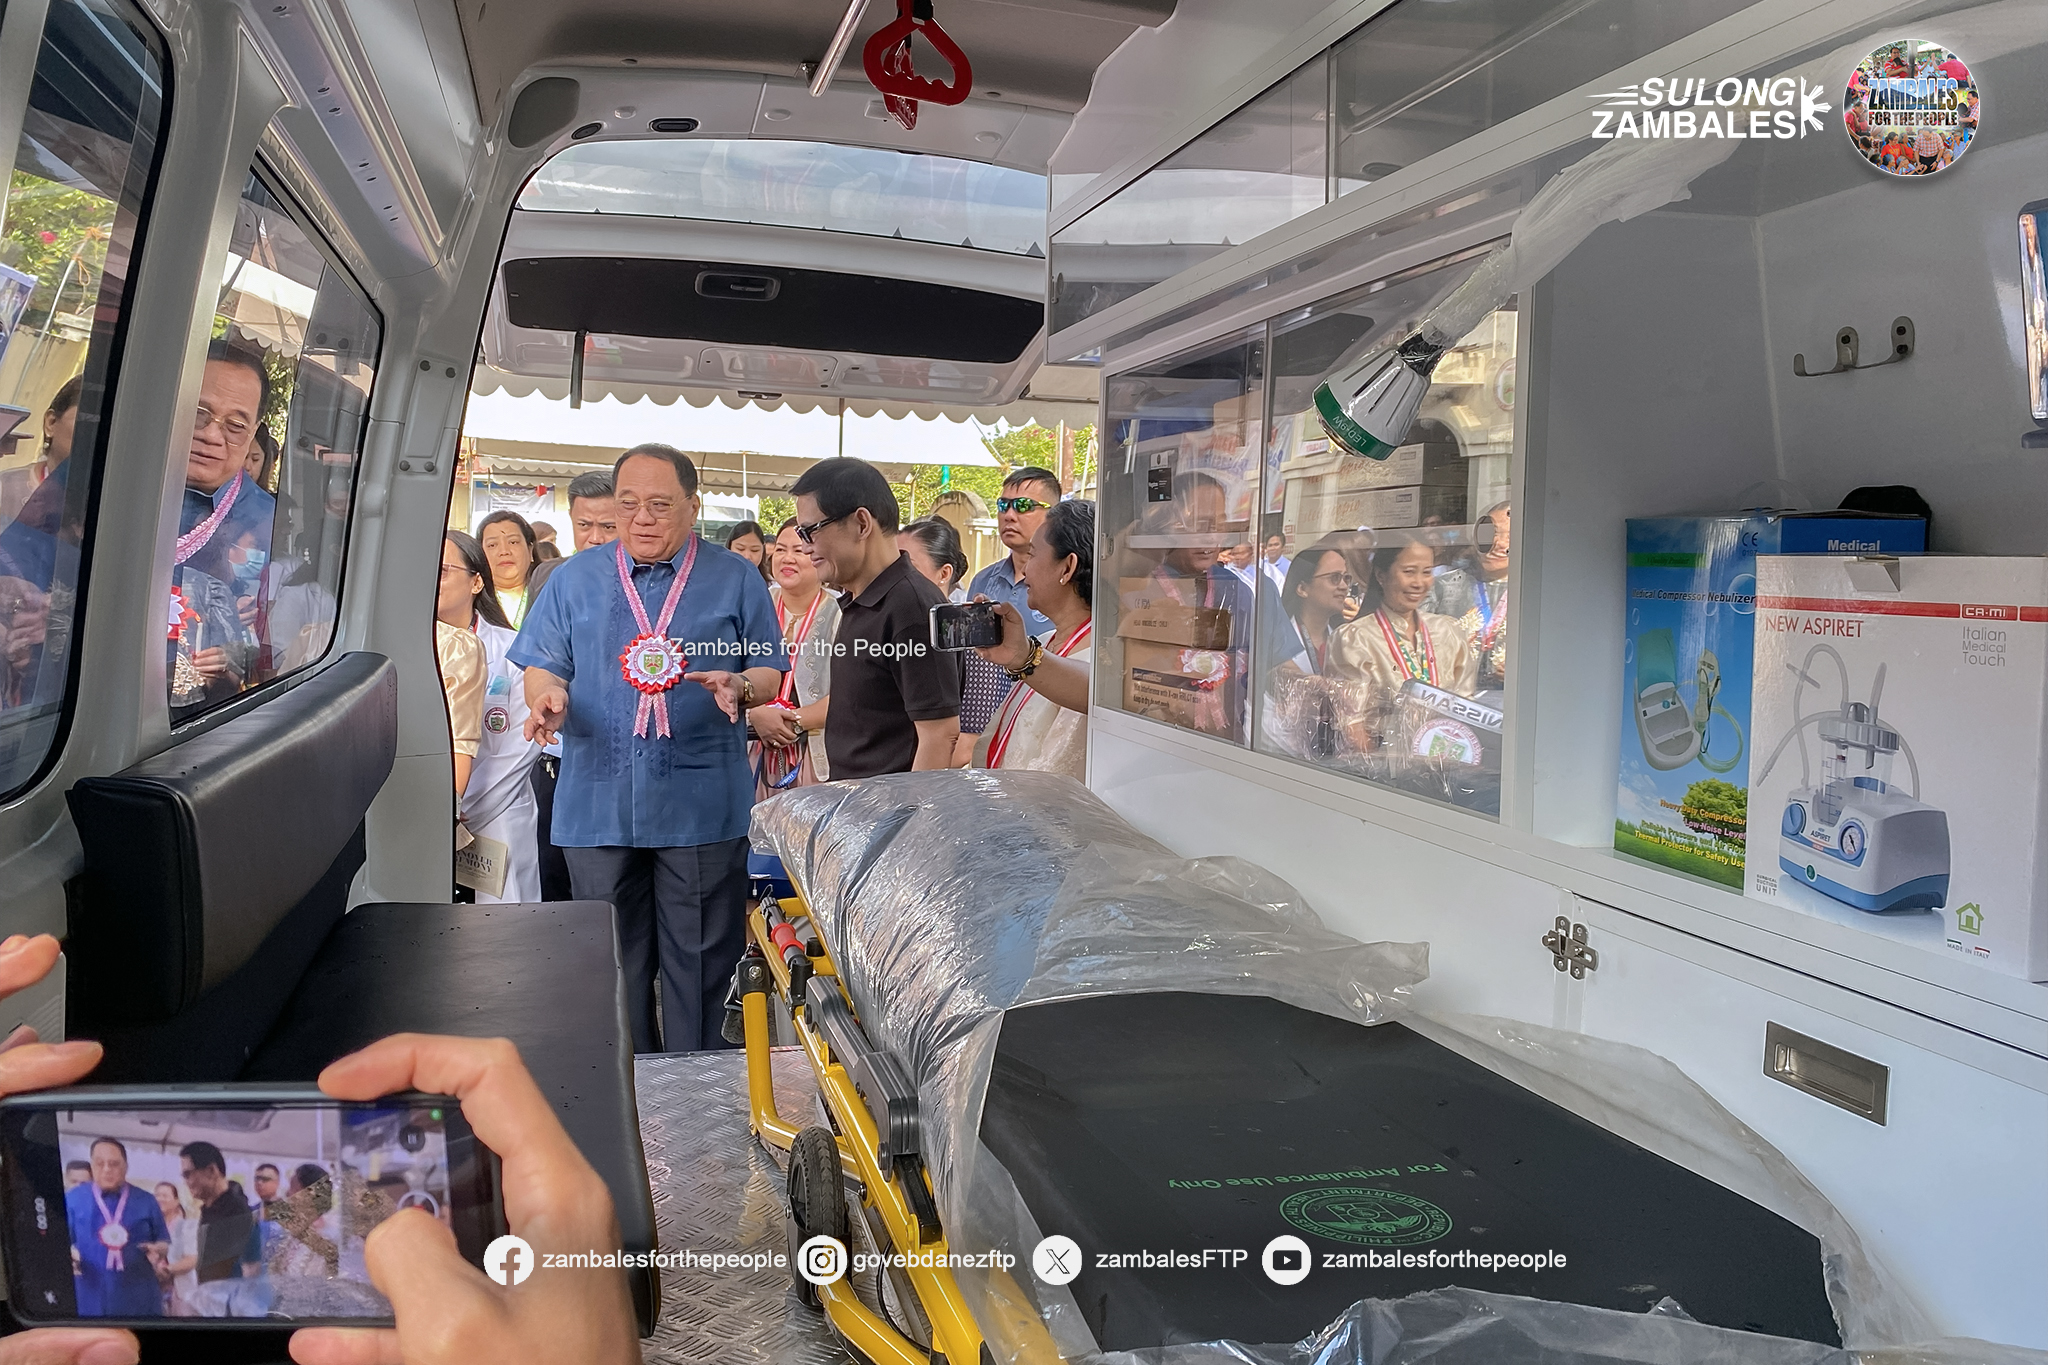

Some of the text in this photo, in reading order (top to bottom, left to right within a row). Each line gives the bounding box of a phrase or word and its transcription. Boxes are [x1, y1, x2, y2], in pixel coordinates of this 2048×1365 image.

[1827, 539, 1881, 551] Medical
[1657, 589, 1705, 602] Compressor
[1707, 591, 1757, 604] Nebulizer
[1765, 614, 1865, 638] NEW ASPIRET
[1962, 626, 2007, 641] Italian
[1962, 640, 2007, 653] Medical
[1962, 651, 2006, 667] Touch
[1699, 808, 1747, 826] Compressor
[1684, 818, 1747, 840] Low-Noise Level
[1810, 829, 1831, 842] ASPIRET
[1634, 829, 1745, 869] Thermal Protector for Safety Use
[1756, 883, 1777, 896] UNIT
[1947, 943, 1990, 960] MADE IN ITALY
[1168, 1162, 1448, 1190] For Ambulance Use Only
